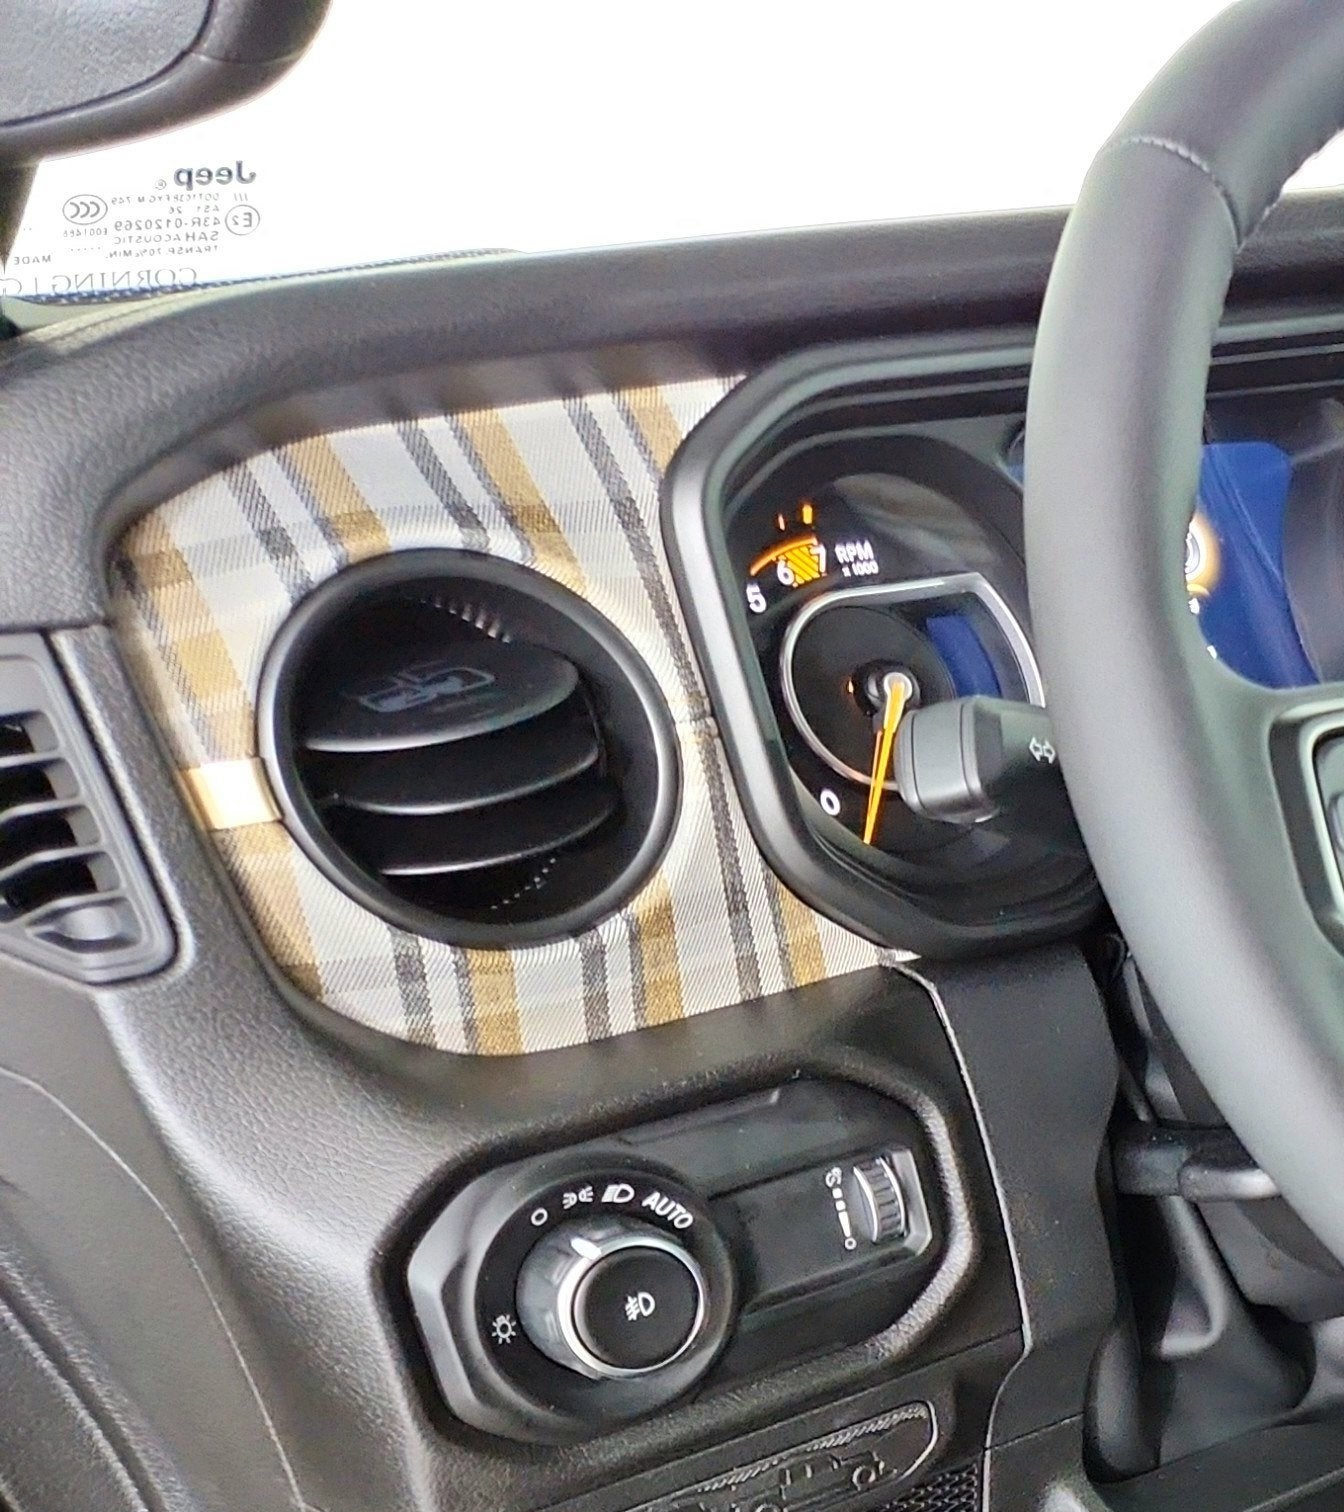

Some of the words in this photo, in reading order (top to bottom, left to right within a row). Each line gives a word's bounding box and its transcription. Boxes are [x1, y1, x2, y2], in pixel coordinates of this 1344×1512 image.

[809, 542, 827, 574] 7
[835, 540, 874, 564] RPM
[777, 555, 795, 586] 6
[746, 583, 767, 613] 5
[642, 1191, 693, 1229] AUTO
